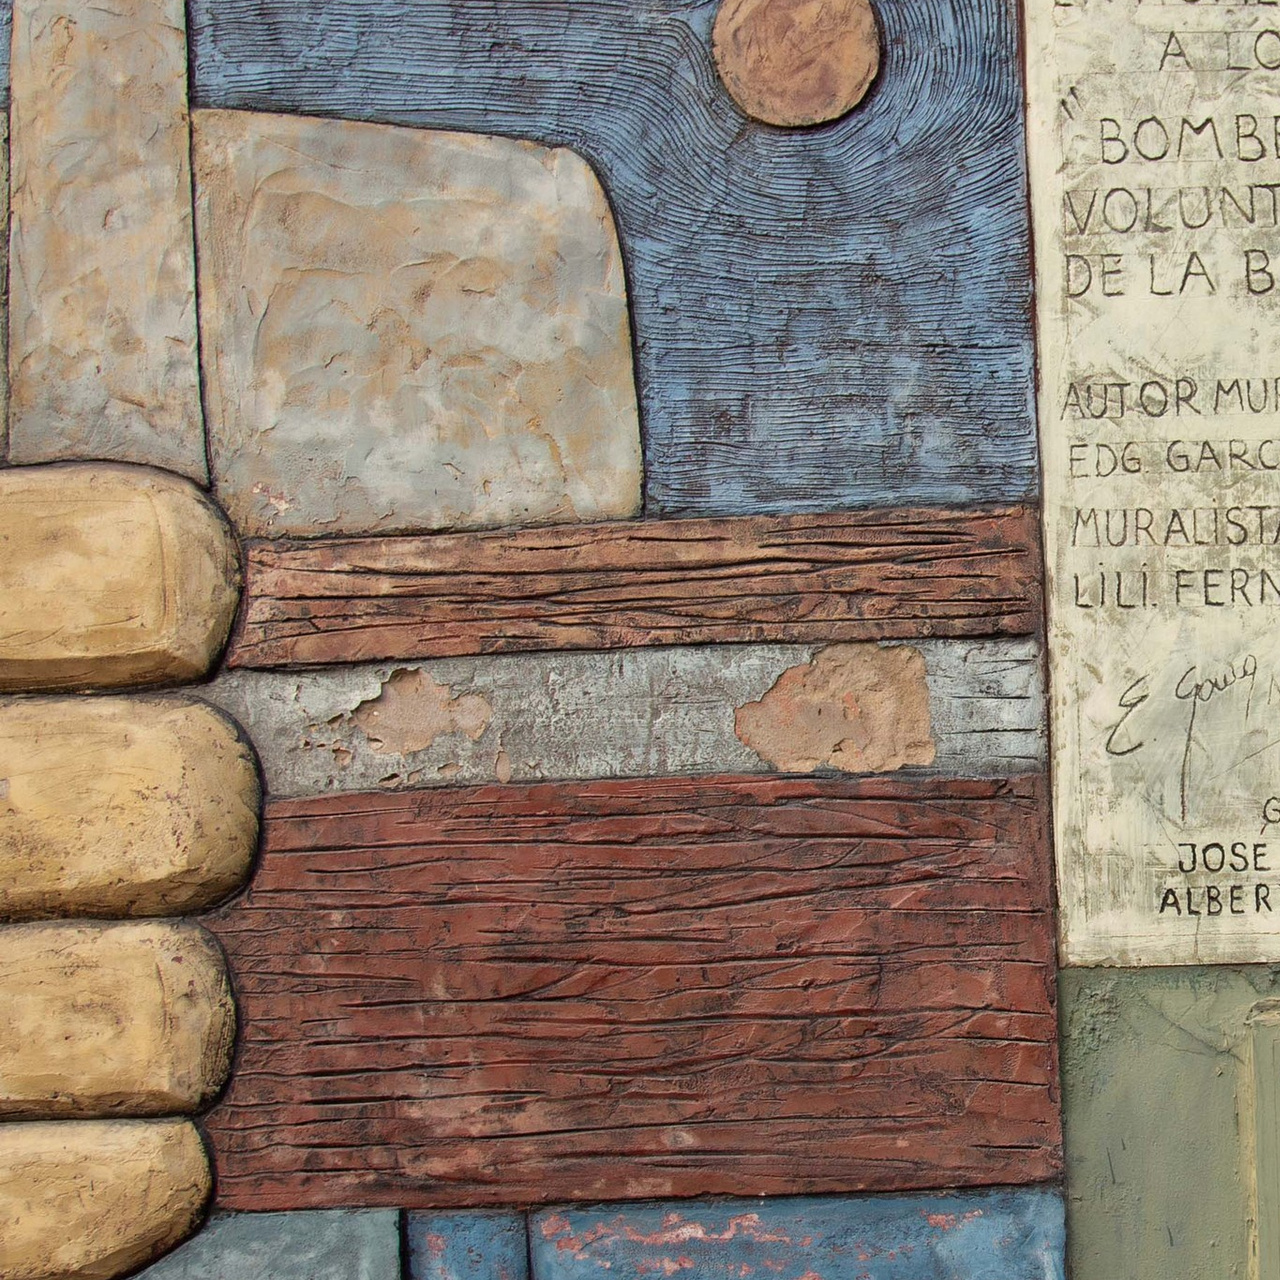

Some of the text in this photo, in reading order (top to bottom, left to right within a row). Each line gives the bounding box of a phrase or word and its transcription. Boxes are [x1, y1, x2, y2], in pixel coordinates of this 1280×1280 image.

[1158, 30, 1192, 71] A
[1065, 253, 1125, 298] DE
[1149, 251, 1217, 296] LA
[1060, 375, 1201, 420] AUTOR
